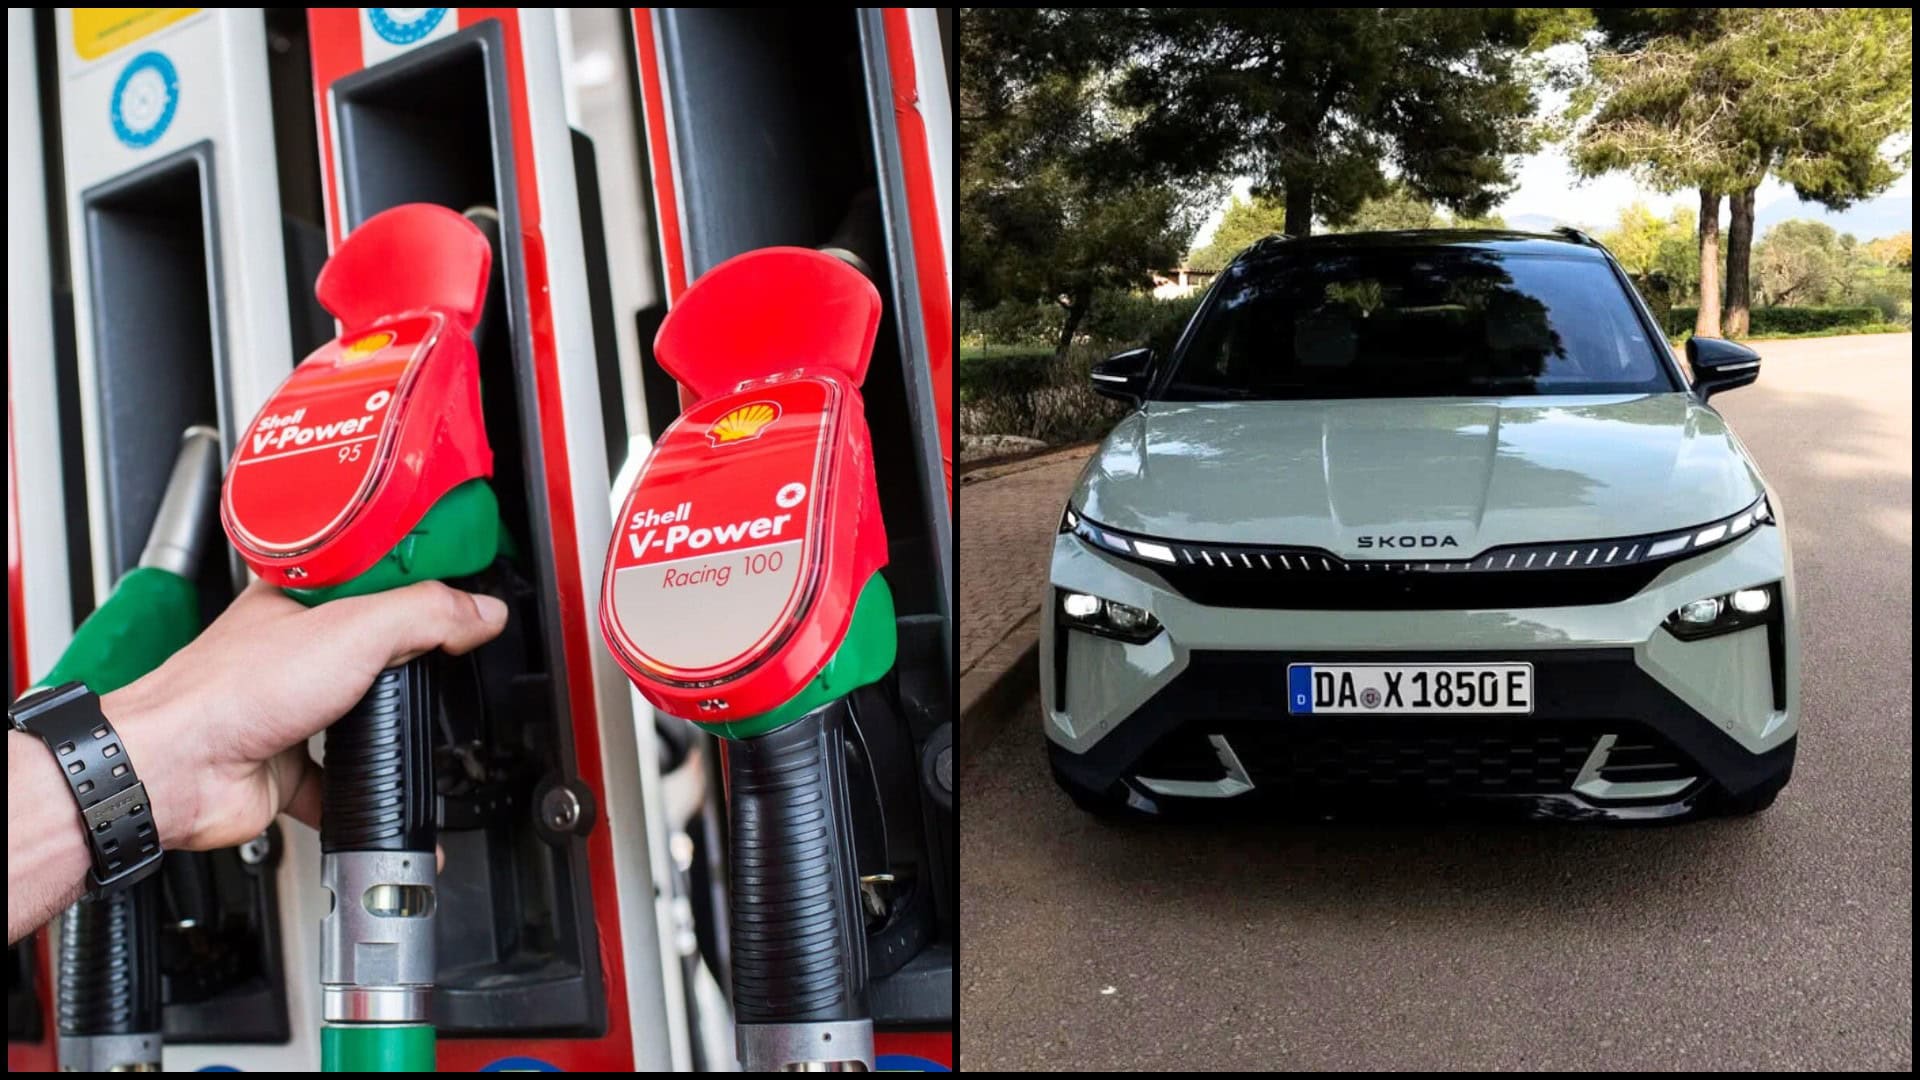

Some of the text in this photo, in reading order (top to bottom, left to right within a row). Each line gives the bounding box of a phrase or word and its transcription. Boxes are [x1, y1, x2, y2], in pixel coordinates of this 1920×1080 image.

[252, 414, 374, 455] V-Power
[256, 408, 307, 433] Shell
[338, 445, 362, 464] 95
[629, 502, 692, 530] Shell
[628, 514, 791, 559] V-Power
[662, 551, 784, 588] Racing 100
